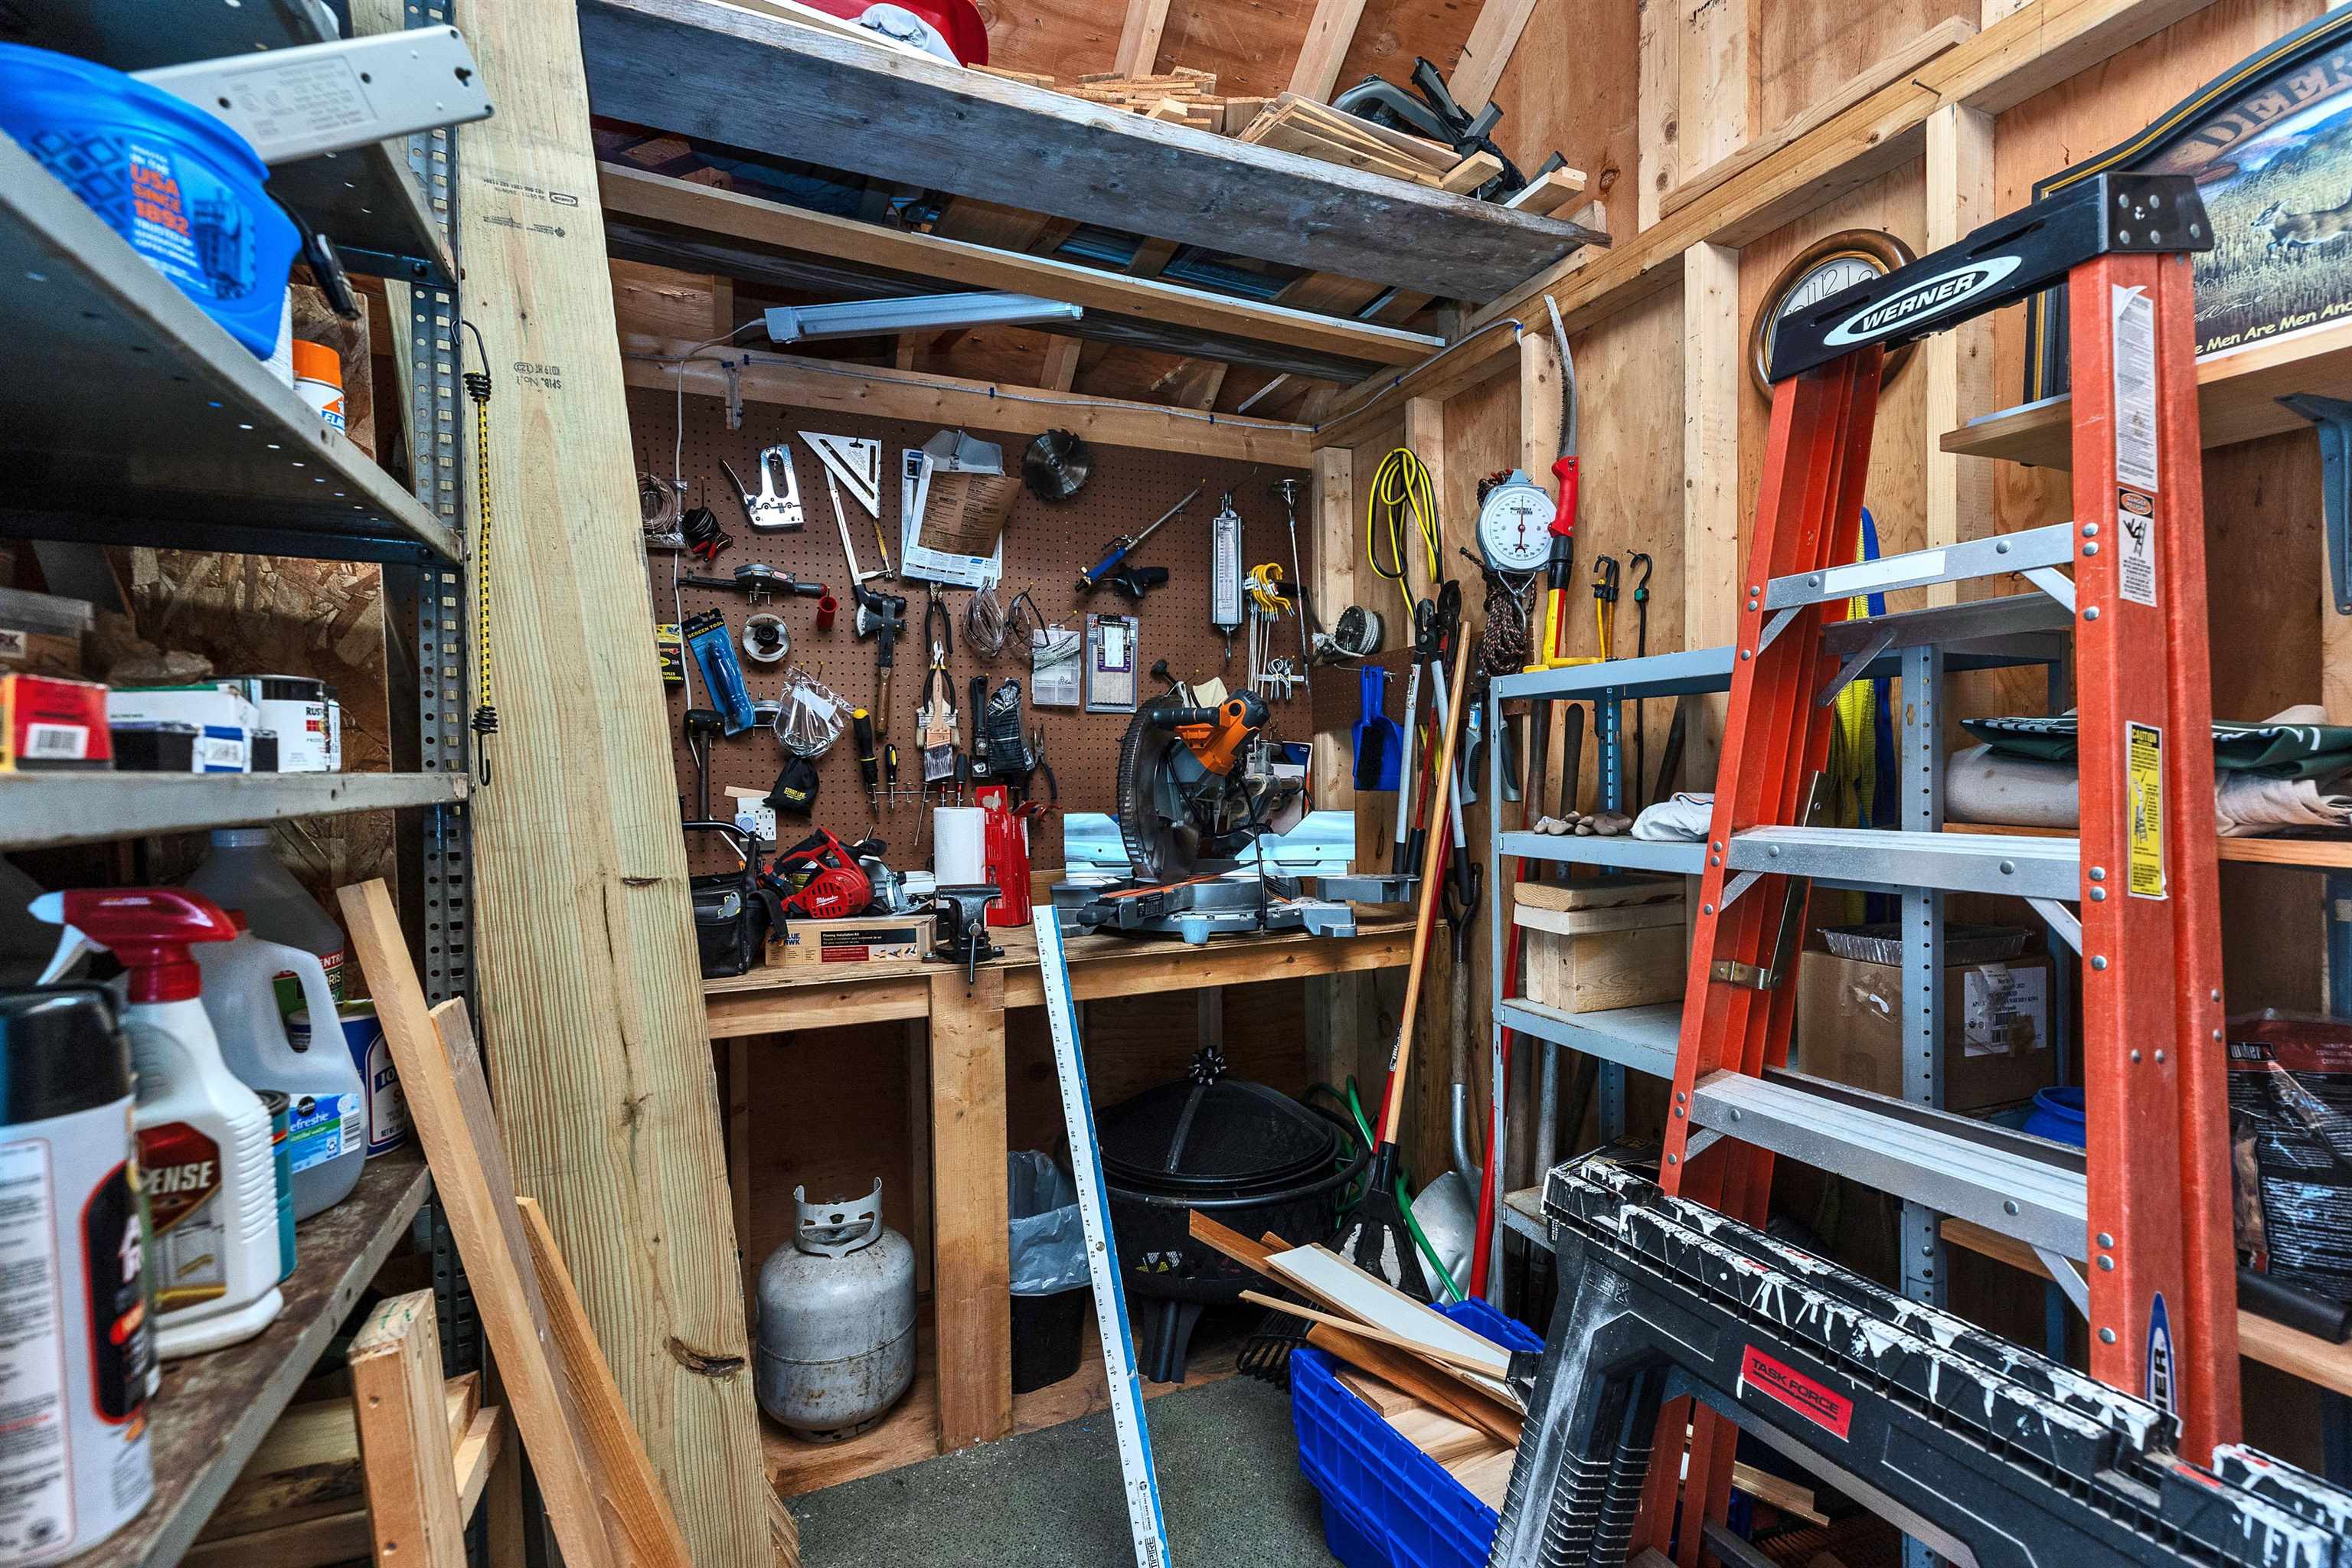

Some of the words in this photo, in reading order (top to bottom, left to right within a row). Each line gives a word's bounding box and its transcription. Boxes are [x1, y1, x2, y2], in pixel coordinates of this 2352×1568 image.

[130, 162, 181, 198] USA
[133, 199, 191, 237] 1892
[1821, 269, 1838, 297] 12
[1862, 273, 1976, 331] WERNER
[2207, 333, 2240, 351] Men
[2244, 323, 2277, 341] Are
[2279, 312, 2317, 331] Men
[688, 626, 709, 638] SCREEN
[710, 621, 724, 630] TOOL
[2132, 728, 2158, 743] CAUTION
[328, 972, 341, 985] RIS
[290, 1110, 329, 1132] efreshe
[1753, 1358, 1787, 1384] TASK
[1789, 1380, 1839, 1413] FORCE
